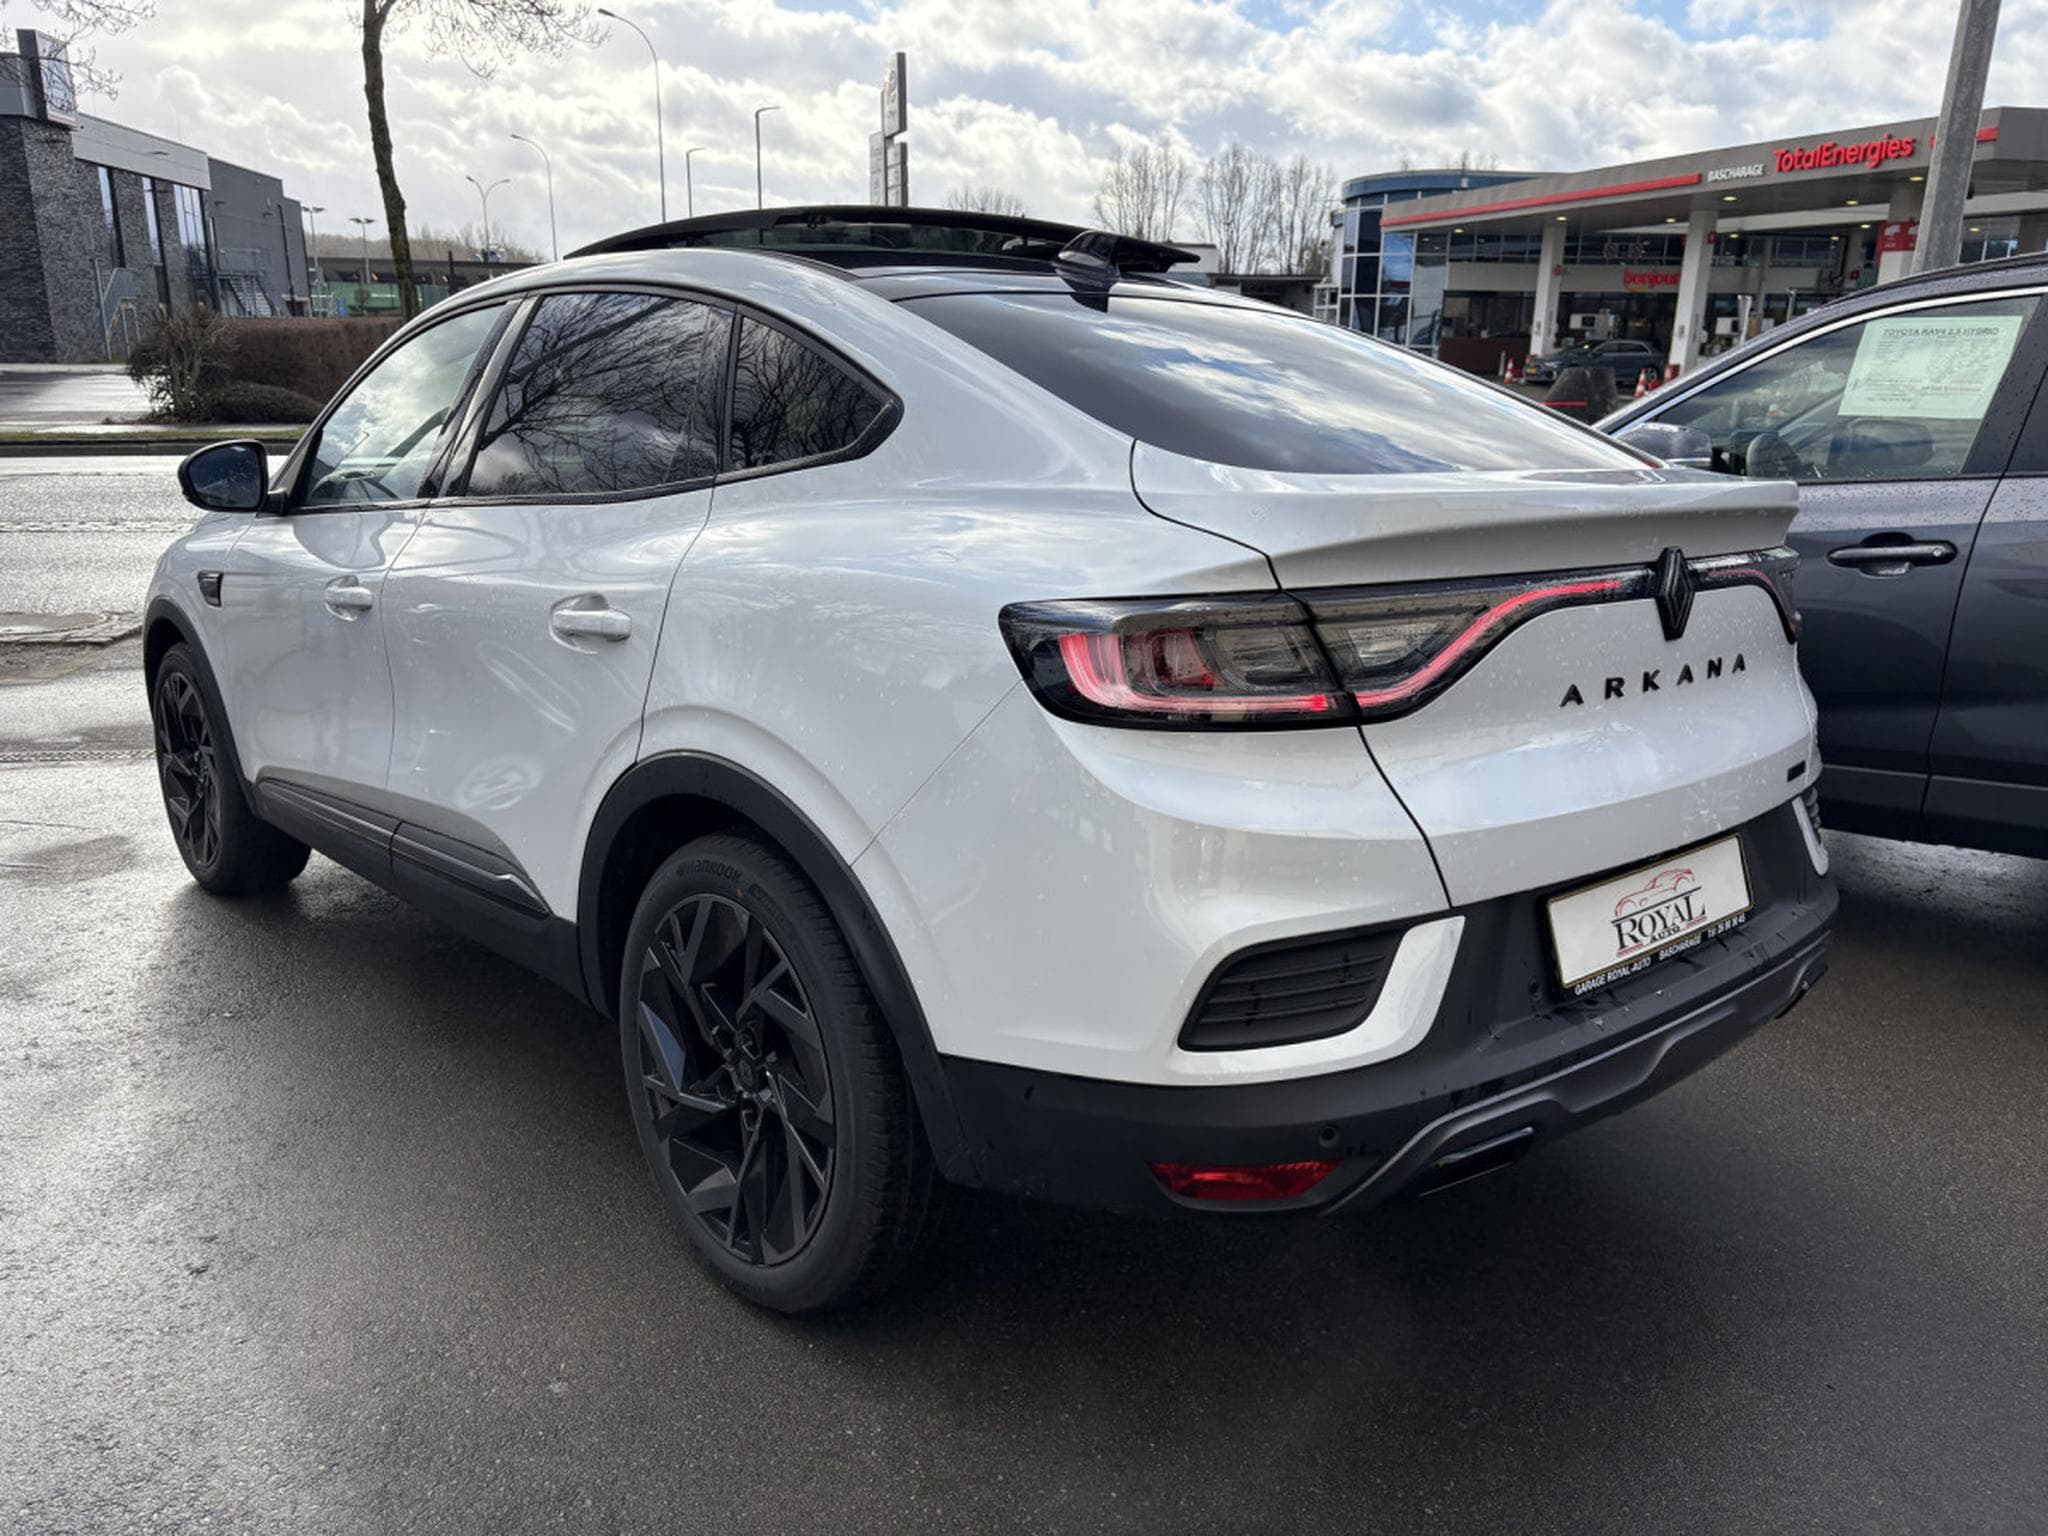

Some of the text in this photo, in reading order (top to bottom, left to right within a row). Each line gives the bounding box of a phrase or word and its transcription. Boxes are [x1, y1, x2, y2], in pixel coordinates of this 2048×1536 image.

[1774, 133, 1916, 172] TotalEnergies
[1707, 164, 1765, 182] BASCHARAGE
[1883, 328, 1920, 336] TOYOTA
[1921, 328, 1947, 336] RAV4
[1963, 327, 2000, 336] HYBRID
[1559, 653, 1746, 708] ARKANA
[1613, 895, 1706, 951] ROYAL
[1649, 922, 1681, 944] AUTO
[1574, 974, 1607, 996] GARAGE
